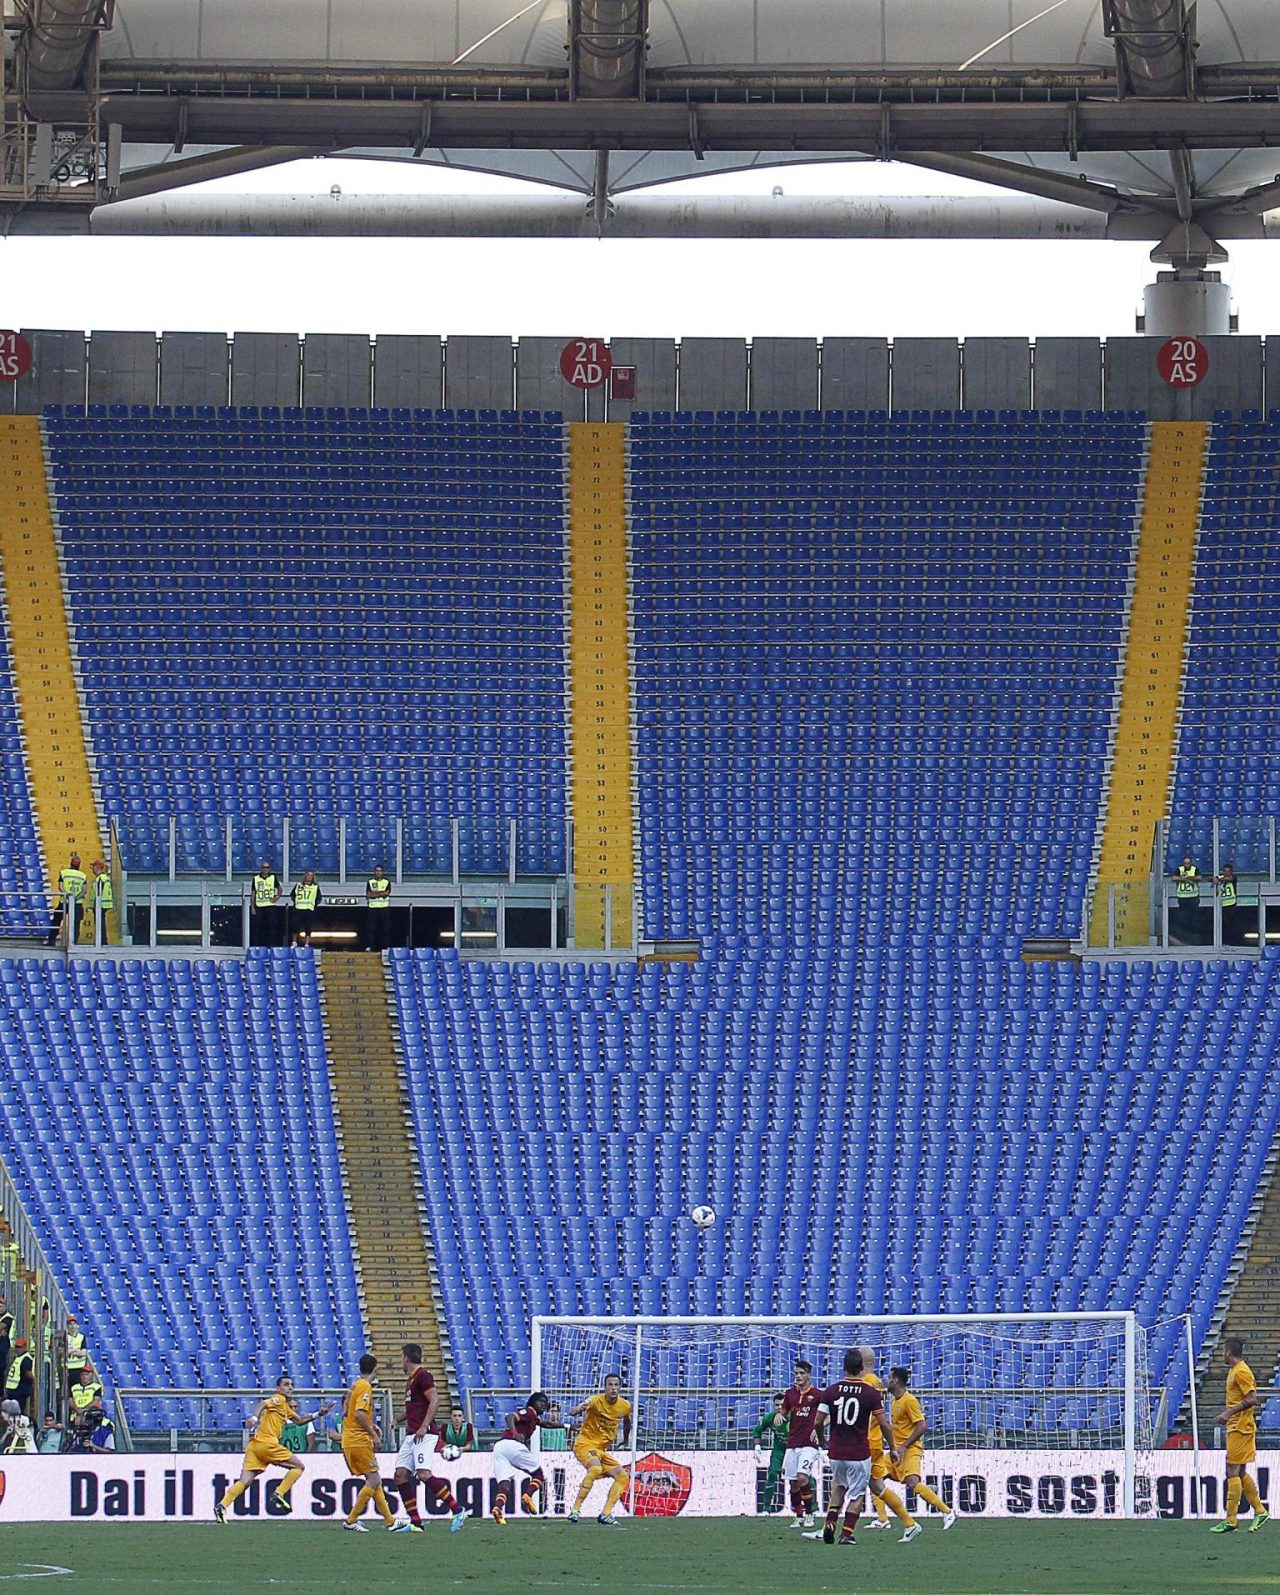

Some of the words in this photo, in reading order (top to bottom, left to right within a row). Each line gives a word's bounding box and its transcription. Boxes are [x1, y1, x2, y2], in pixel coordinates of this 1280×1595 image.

[575, 342, 598, 362] 21
[1171, 341, 1196, 362] 20
[571, 364, 603, 384] AD
[1169, 363, 1197, 383] AS
[838, 1384, 863, 1394] TOTTI
[833, 1396, 860, 1427] 10
[417, 1452, 425, 1464] 6
[71, 1470, 145, 1516] Dai
[165, 1470, 193, 1516] il
